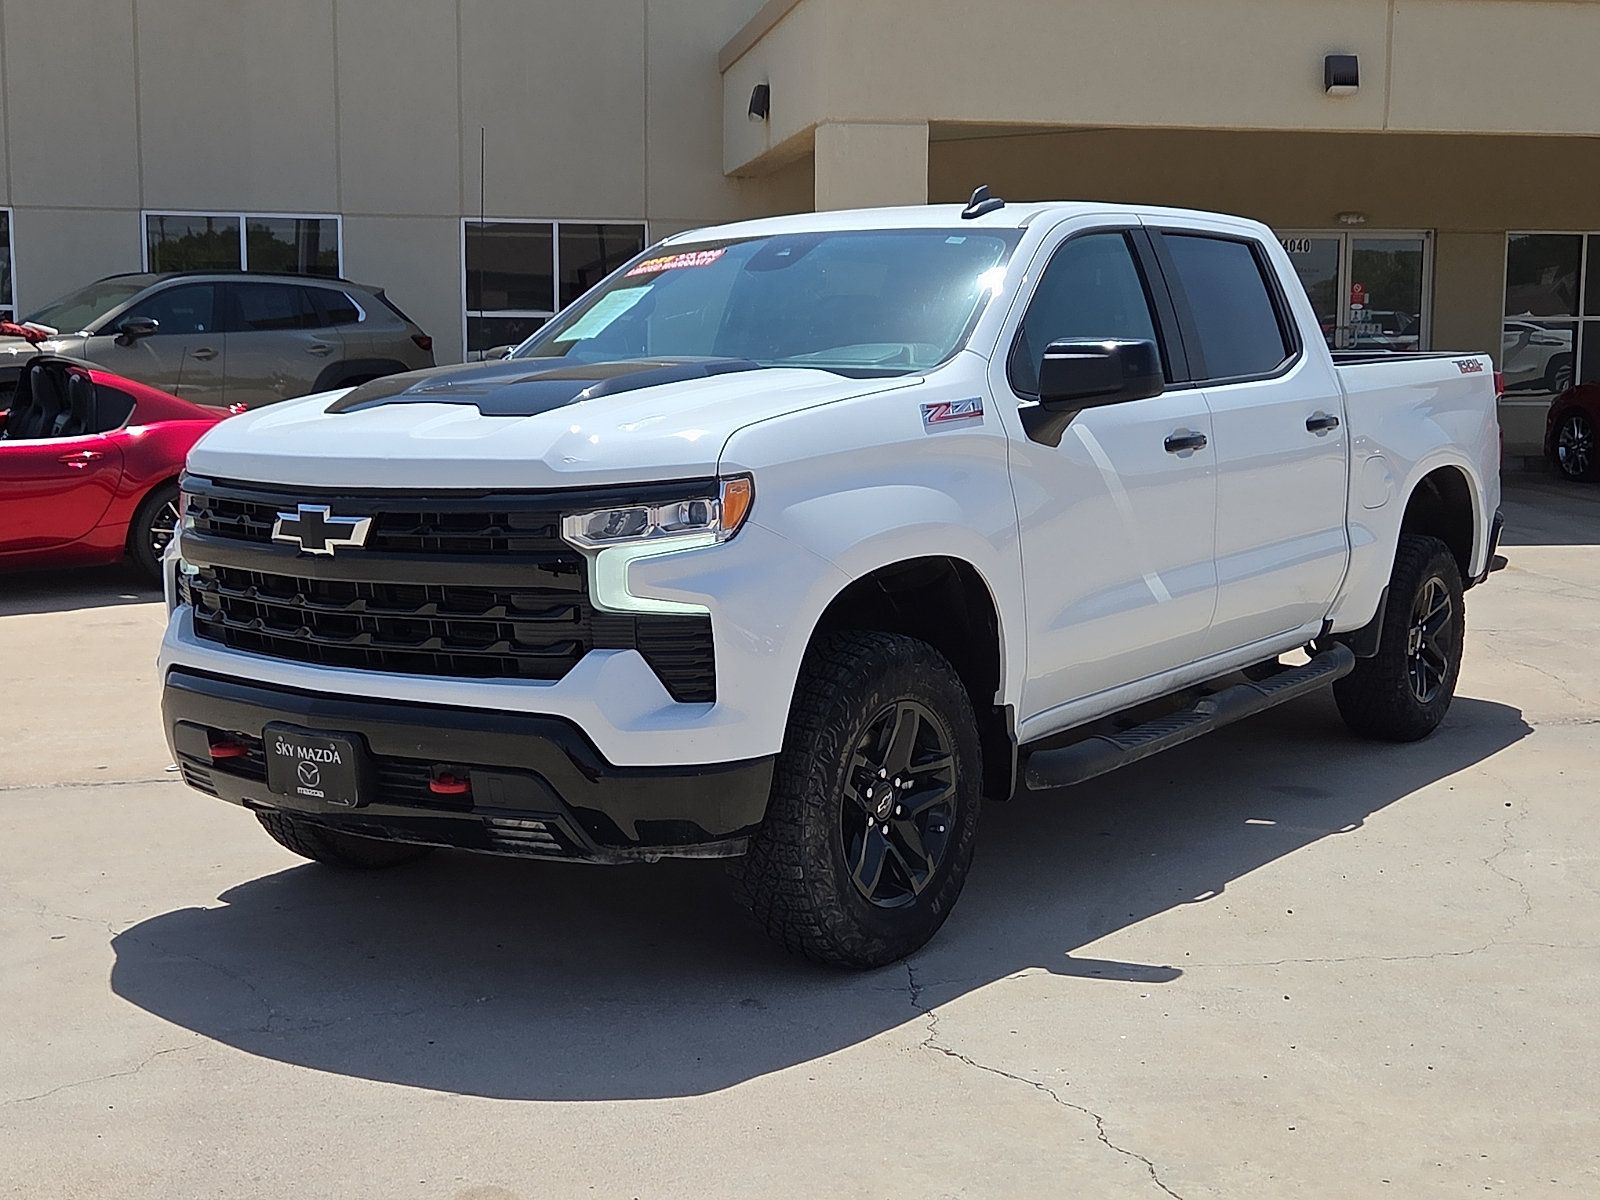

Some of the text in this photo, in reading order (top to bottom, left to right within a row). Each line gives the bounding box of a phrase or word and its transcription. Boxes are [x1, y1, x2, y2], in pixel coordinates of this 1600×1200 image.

[1282, 239, 1311, 253] 4040
[275, 741, 342, 765] SKY MAZDA
